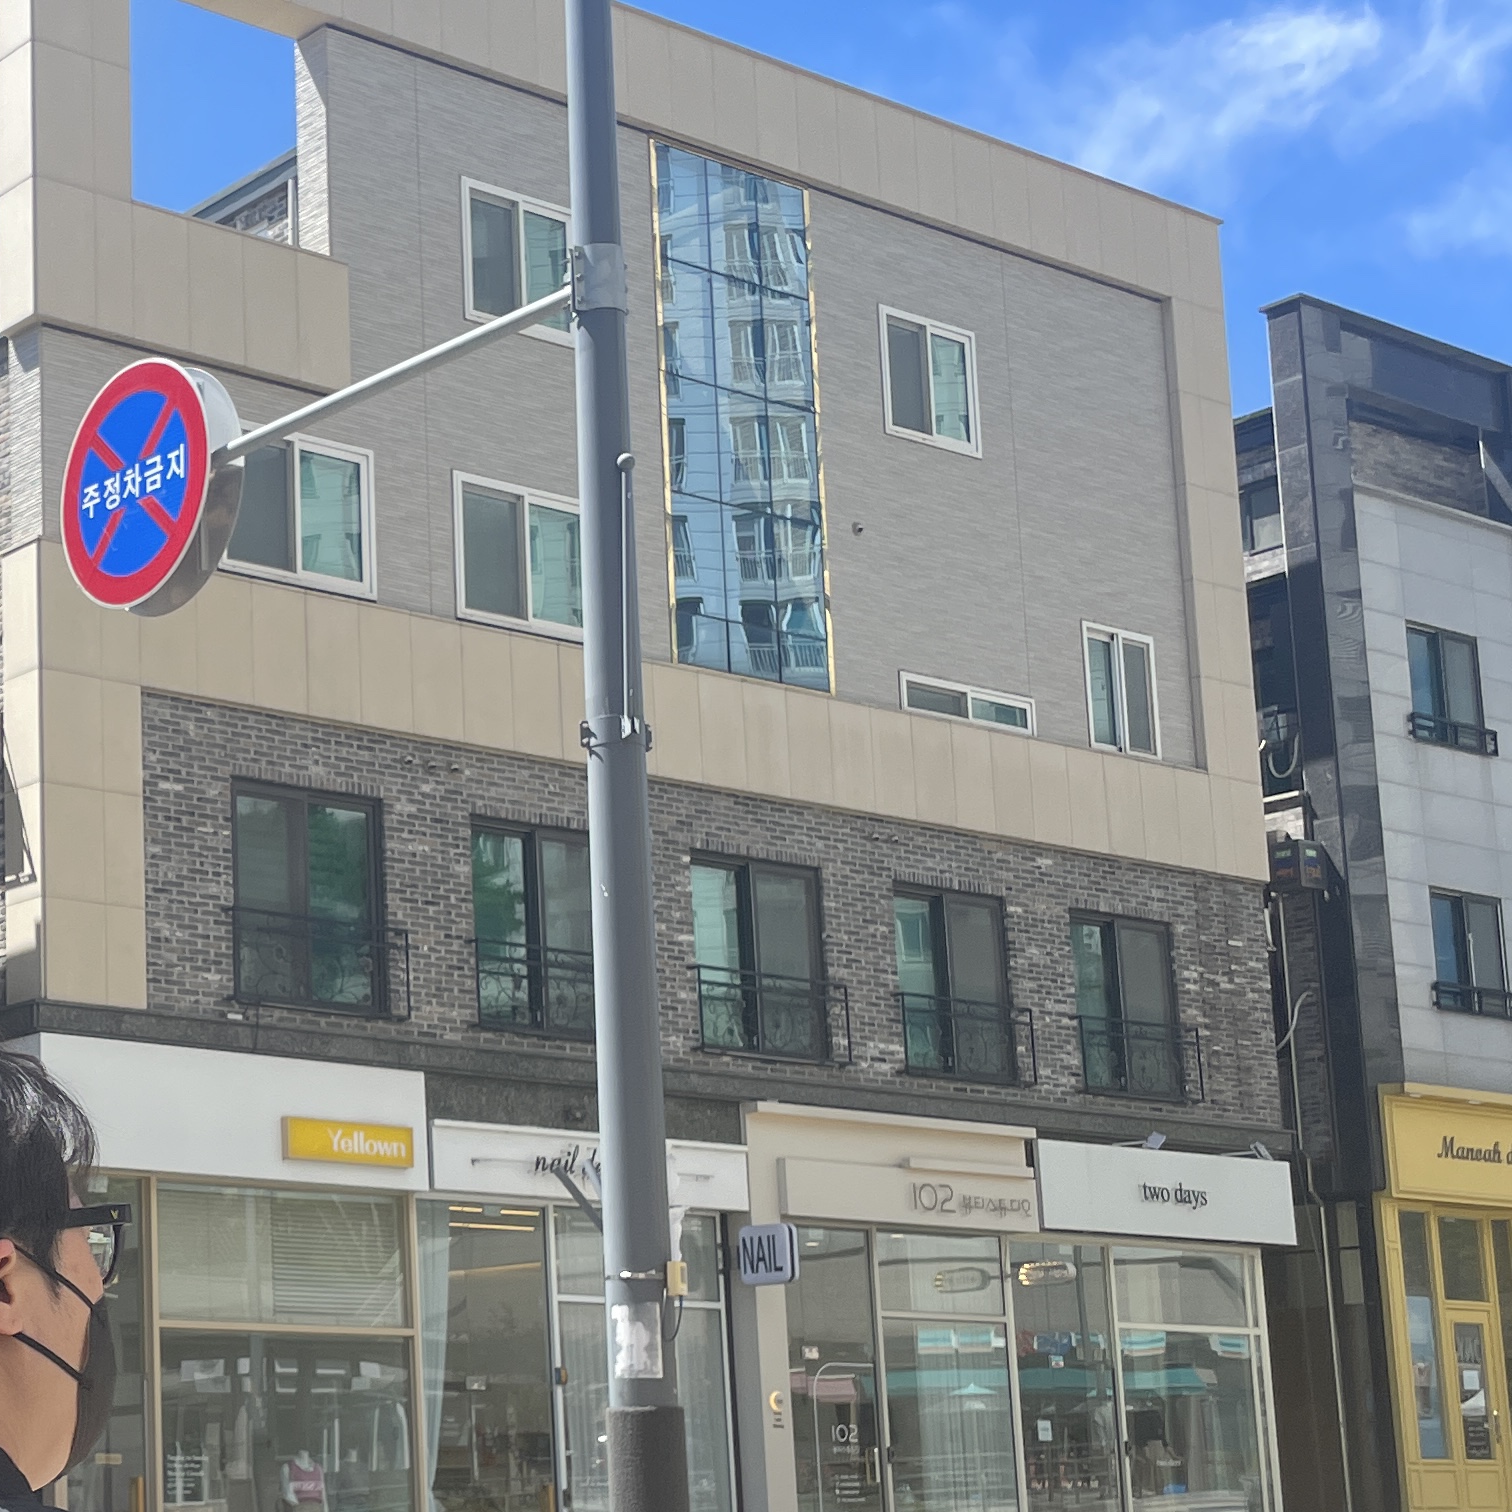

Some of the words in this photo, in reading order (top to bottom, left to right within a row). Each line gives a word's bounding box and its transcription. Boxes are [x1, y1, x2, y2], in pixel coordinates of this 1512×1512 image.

[81, 444, 185, 518] 주정차금지
[327, 1127, 406, 1158] Yellown
[912, 1182, 956, 1213] 102
[1142, 1182, 1170, 1203] two
[1174, 1182, 1208, 1210] days
[741, 1234, 784, 1275] NAIL
[832, 1424, 858, 1442] 102
